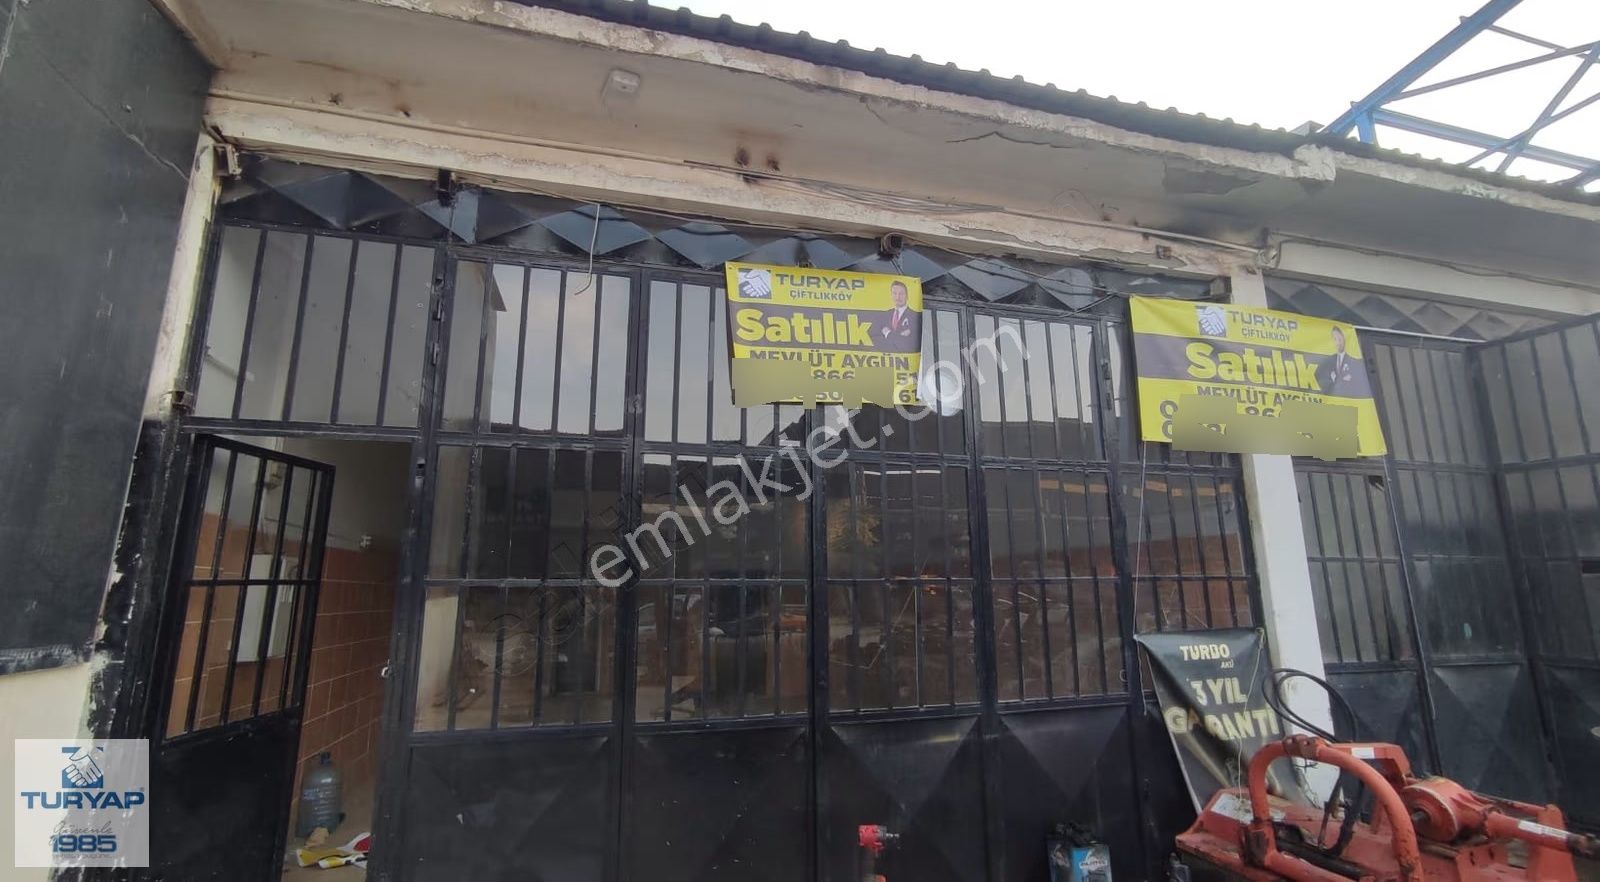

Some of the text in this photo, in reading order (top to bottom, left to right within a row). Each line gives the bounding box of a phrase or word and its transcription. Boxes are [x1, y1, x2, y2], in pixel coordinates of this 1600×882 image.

[775, 273, 865, 290] TURYAP
[736, 308, 875, 346] Satılık
[1227, 310, 1299, 331] TURYAP
[1185, 342, 1321, 391] Satılık
[1190, 677, 1248, 706] 3 YIL
